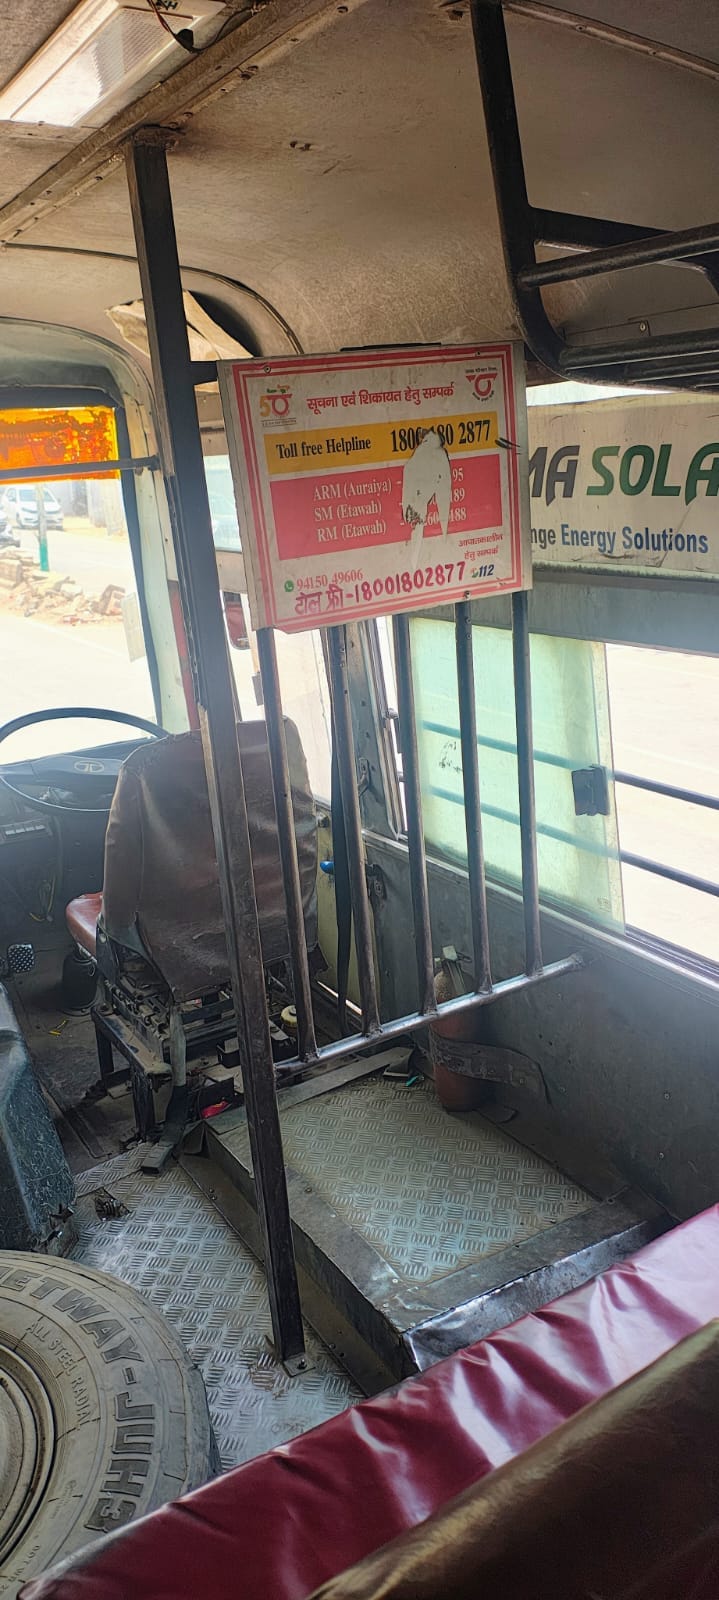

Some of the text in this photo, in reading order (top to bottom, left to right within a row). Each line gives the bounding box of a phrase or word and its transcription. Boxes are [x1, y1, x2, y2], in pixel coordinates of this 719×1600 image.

[306, 394, 338, 415] सूचना
[341, 390, 357, 407] एवं
[358, 388, 402, 405] शिकायत
[404, 386, 421, 406] हेतु
[422, 381, 455, 400] सम्पर्क
[276, 443, 298, 459] Toll
[301, 441, 323, 457] free
[325, 436, 371, 455] Helpline
[458, 419, 491, 445] 2877
[314, 484, 341, 501] ARM
[344, 479, 392, 498] (Auraiya)
[314, 506, 333, 522] SM
[337, 500, 382, 520] (Etawah)
[317, 526, 338, 543] RM
[342, 519, 387, 540] (Etawah)
[561, 524, 616, 553] Energy
[622, 526, 709, 553] Solutions
[296, 568, 364, 590] 94150 49606
[479, 564, 495, 578] 112
[295, 592, 323, 614] टोल
[48, 1338, 78, 1377] STEEL
